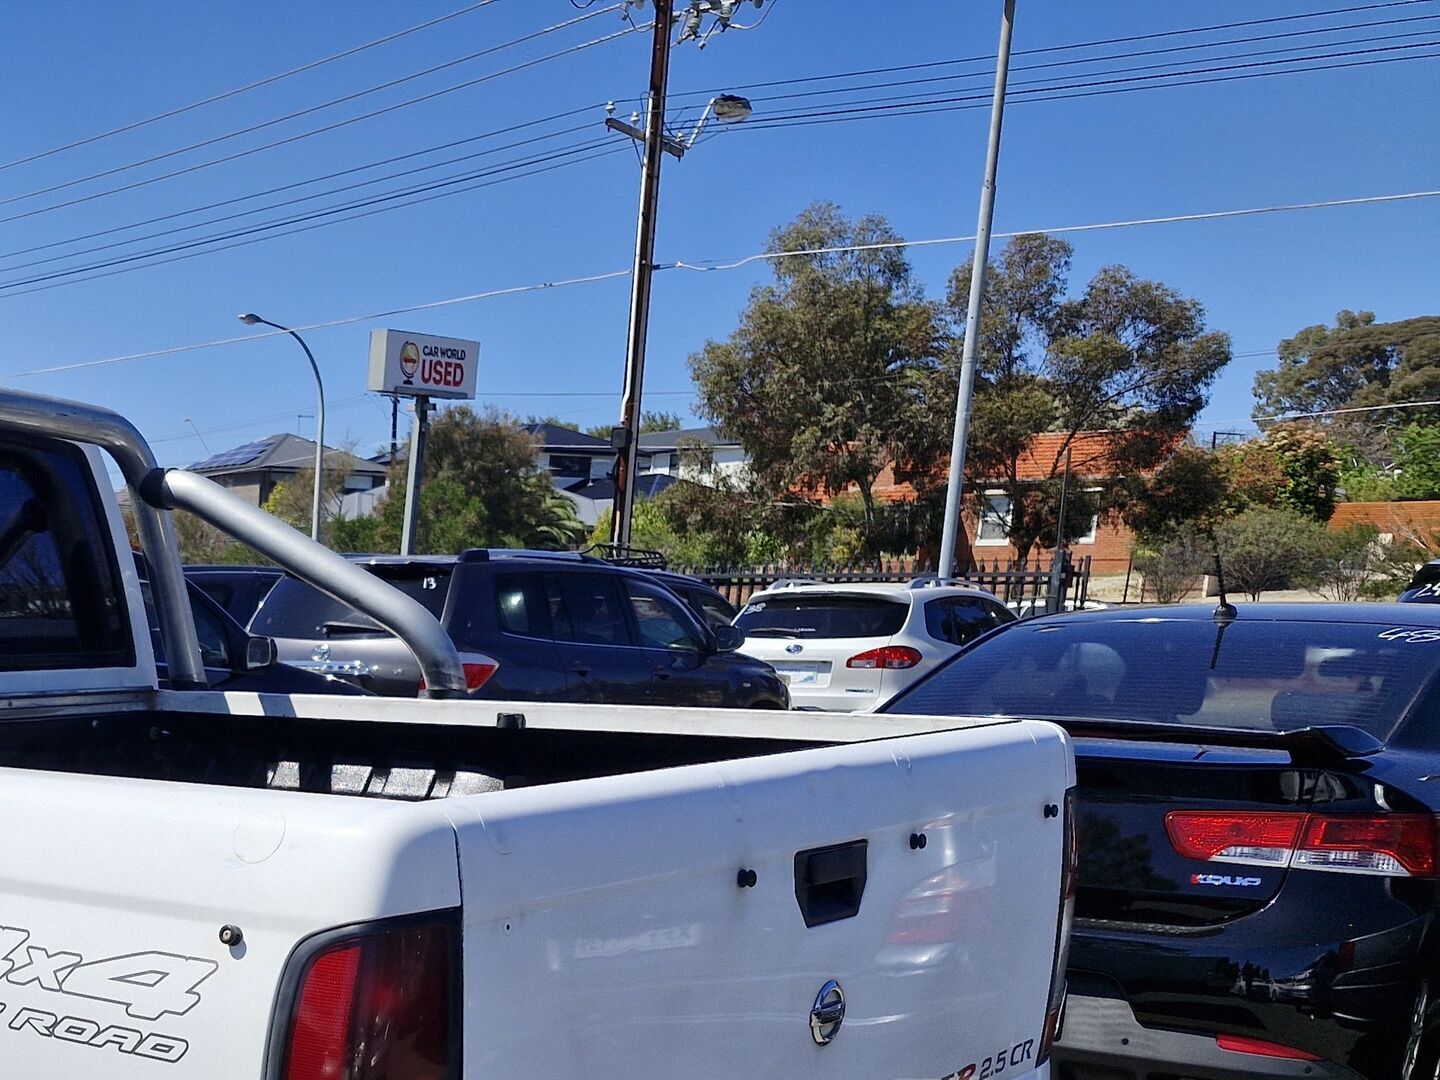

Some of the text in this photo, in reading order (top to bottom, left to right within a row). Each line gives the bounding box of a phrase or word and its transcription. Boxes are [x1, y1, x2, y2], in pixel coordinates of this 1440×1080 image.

[422, 345, 466, 361] CAR WORLD
[421, 359, 464, 387] USED
[9, 1007, 189, 1063] ROAD
[1010, 1038, 1035, 1067] CR
